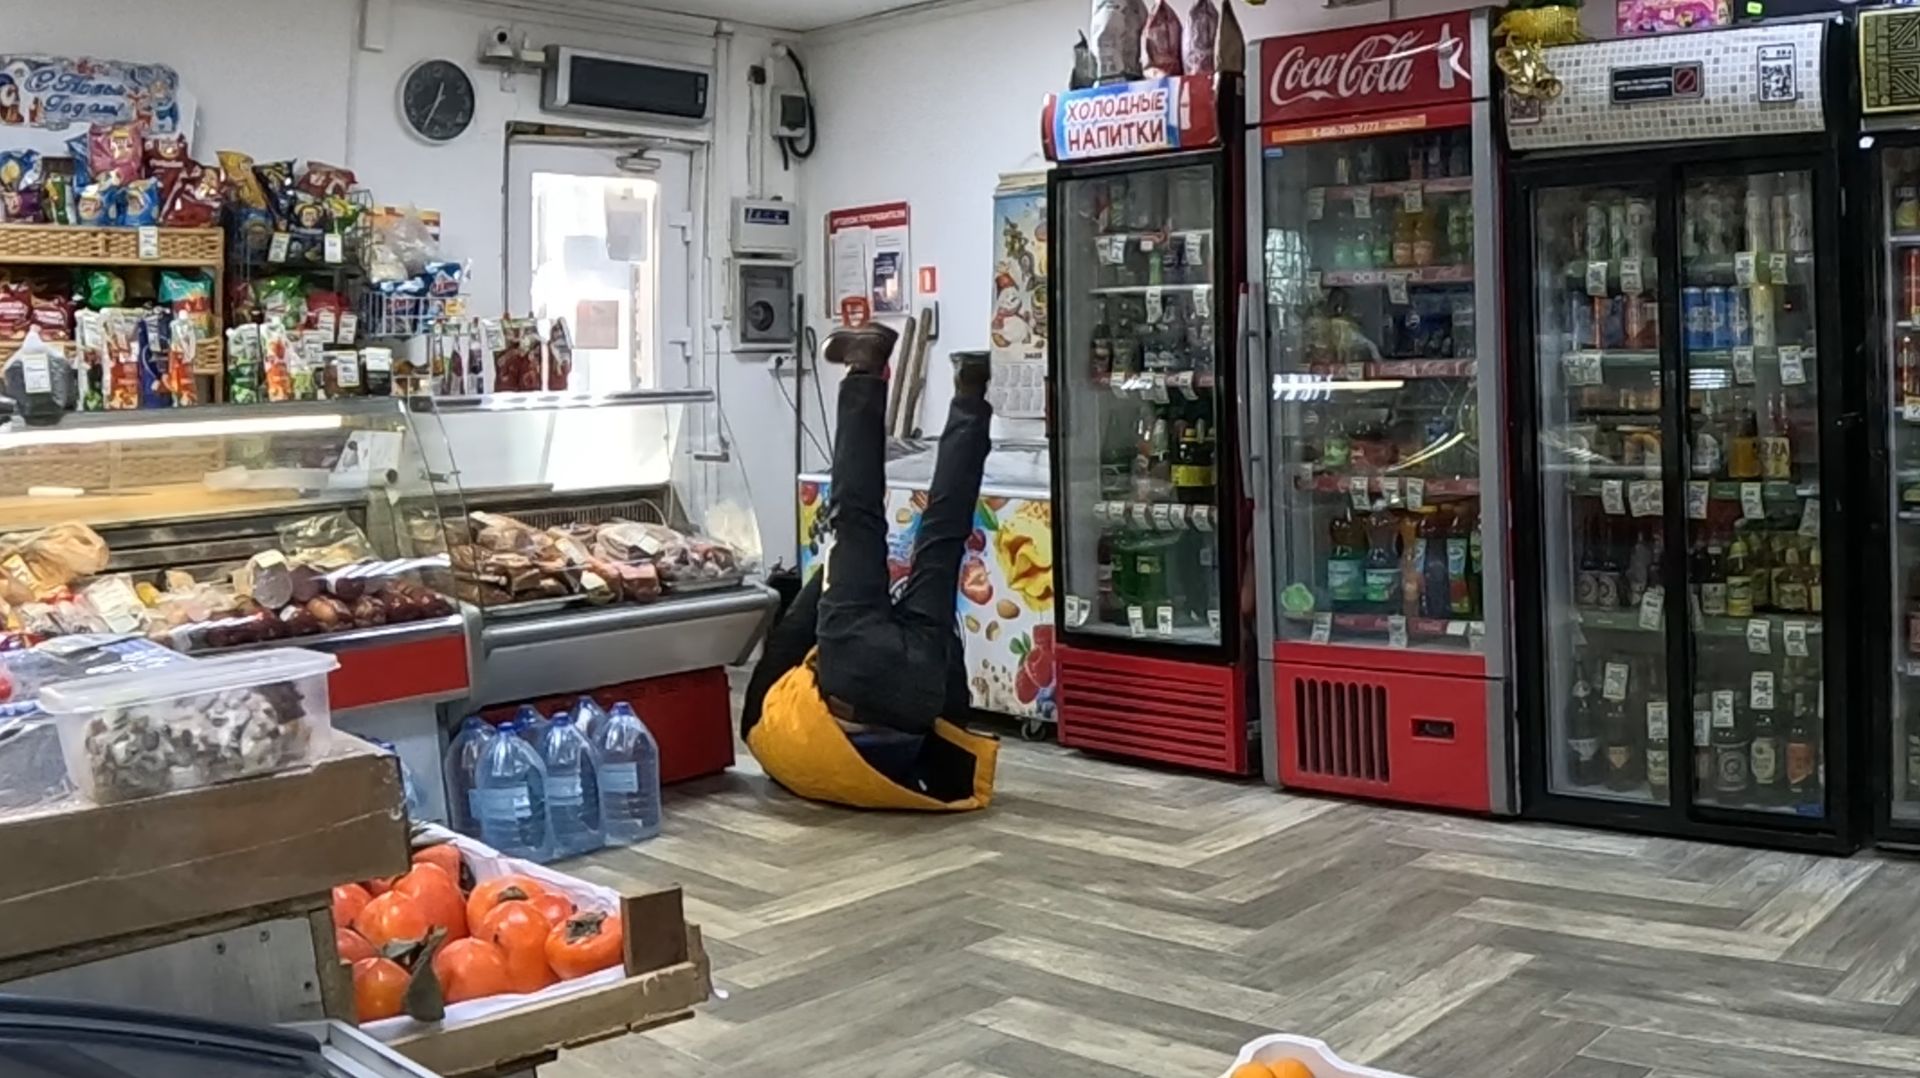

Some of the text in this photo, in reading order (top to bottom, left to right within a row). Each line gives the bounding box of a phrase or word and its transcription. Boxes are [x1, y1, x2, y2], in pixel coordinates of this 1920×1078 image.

[24, 66, 56, 93] С
[1270, 29, 1424, 105] Coca-Cola
[1067, 92, 1165, 122] ХОЛОДНЫЕ
[1068, 119, 1164, 151] НАПИТКИ
